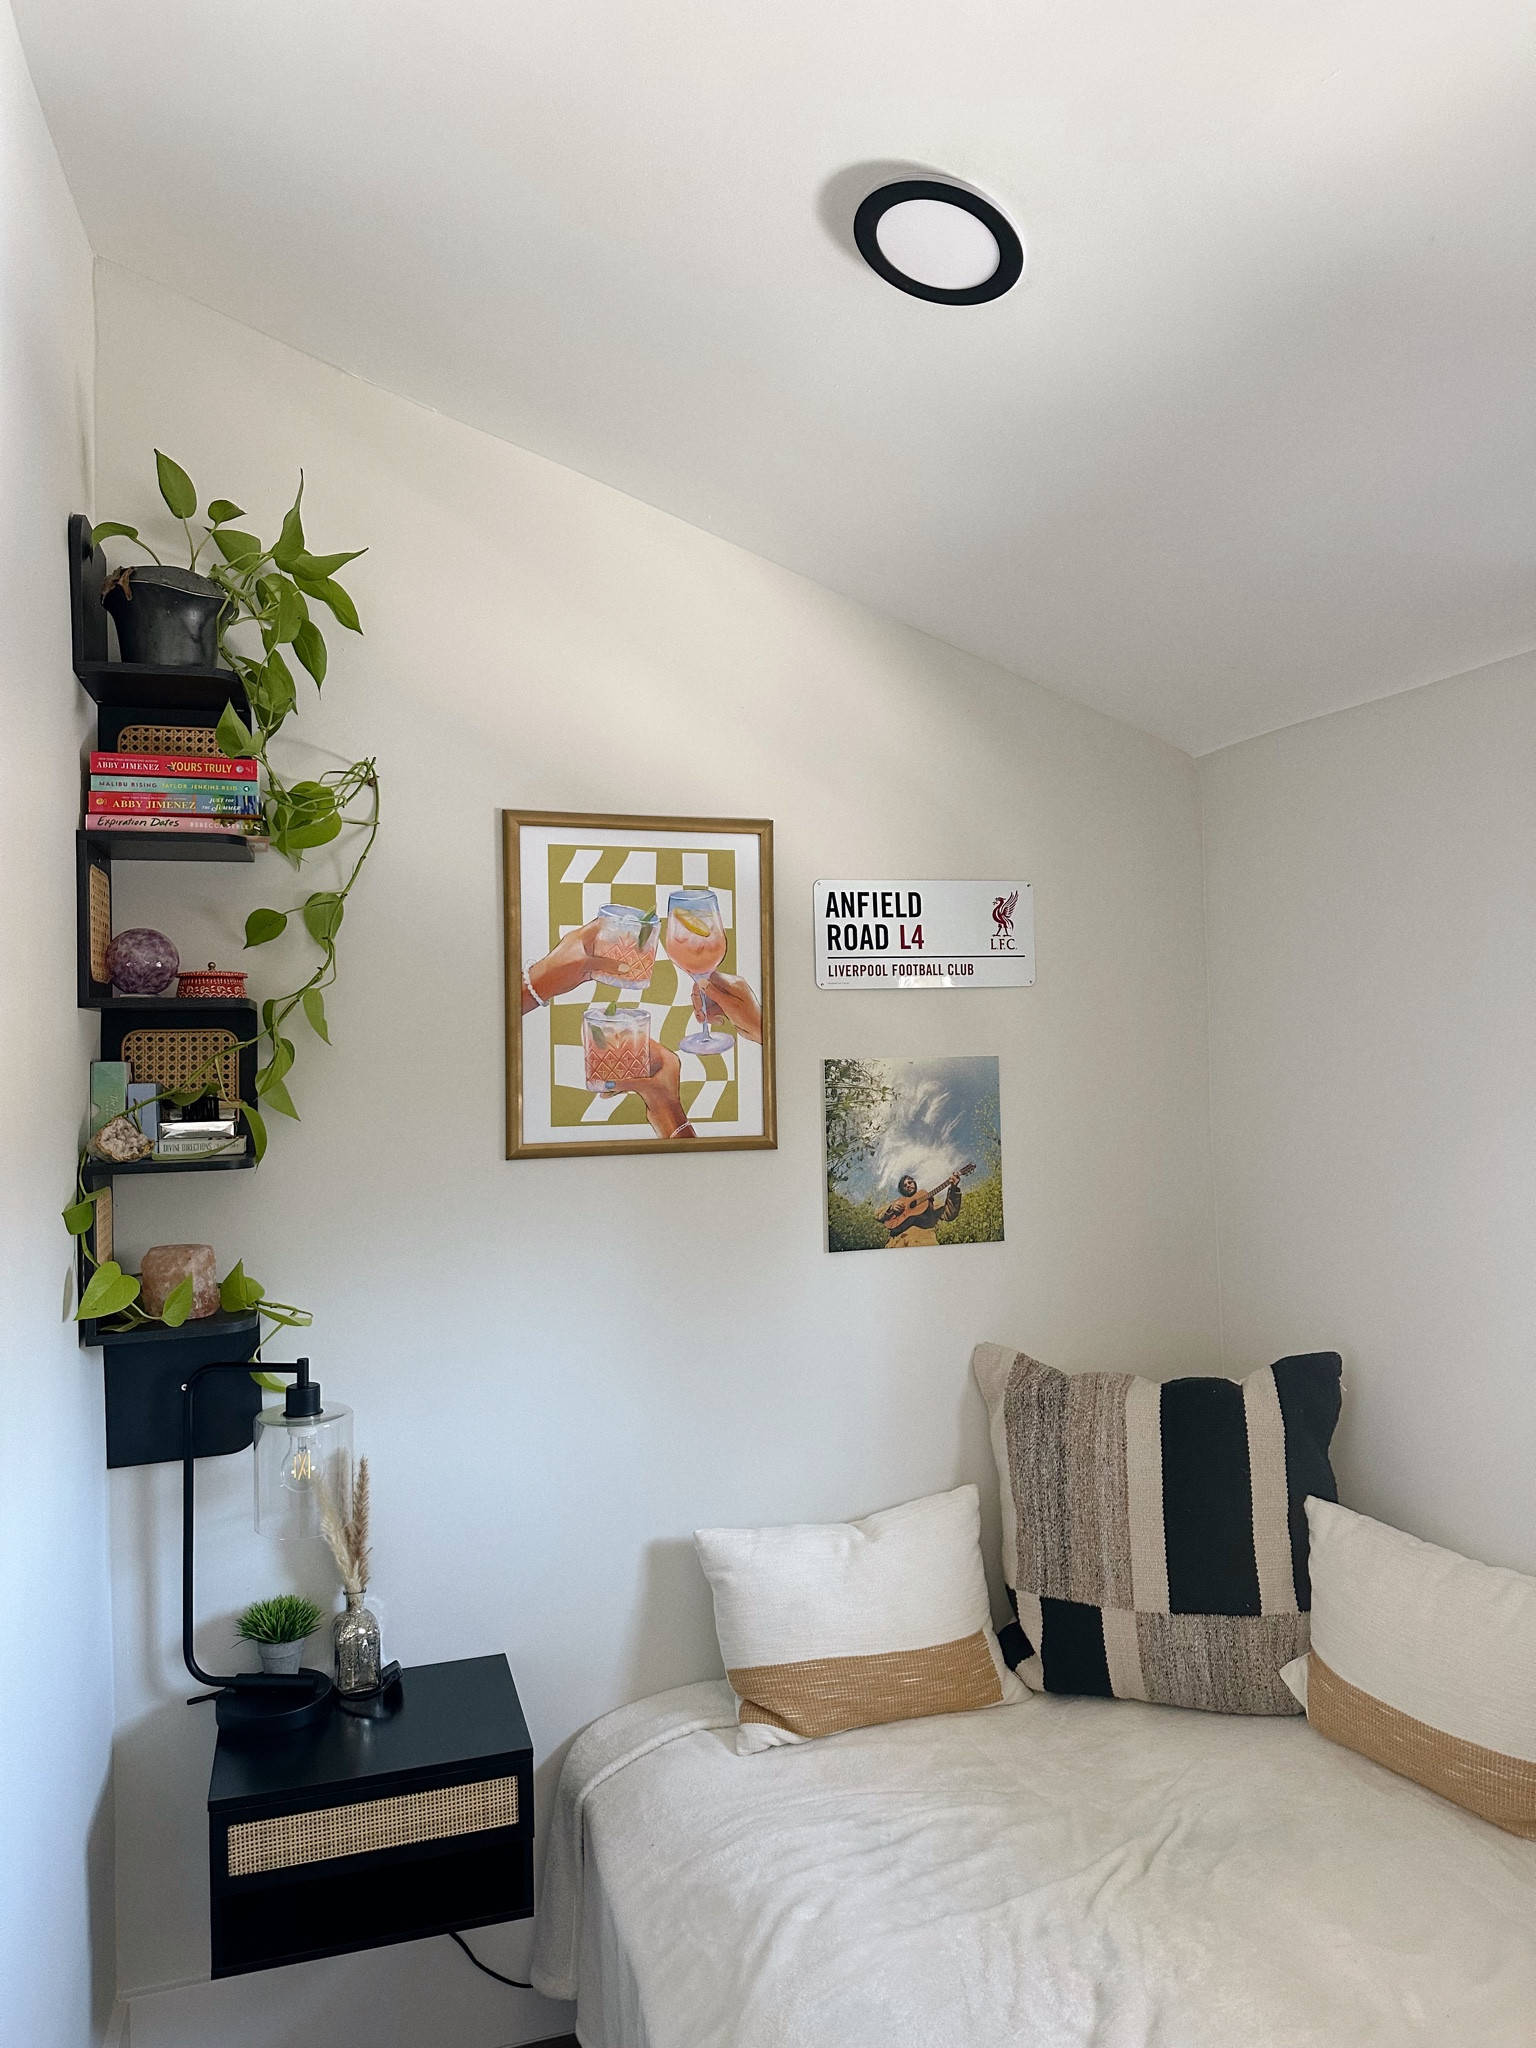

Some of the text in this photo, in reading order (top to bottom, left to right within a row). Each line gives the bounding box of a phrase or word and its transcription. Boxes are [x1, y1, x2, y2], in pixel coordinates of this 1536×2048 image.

[121, 763, 159, 771] JIMENEZ
[171, 762, 232, 773] YOURS TRULY
[113, 800, 196, 809] ABBY JIMENEZ
[98, 816, 179, 827] Expiration Dates
[826, 892, 922, 918] ANFIELD
[827, 925, 924, 950] ROAD L4
[990, 938, 1017, 950] L.F.C.
[828, 963, 974, 977] LIVERPOOL FOOTBALL CLUB
[163, 1144, 179, 1152] DIVINE
[182, 1143, 212, 1151] DIRECTIONS
